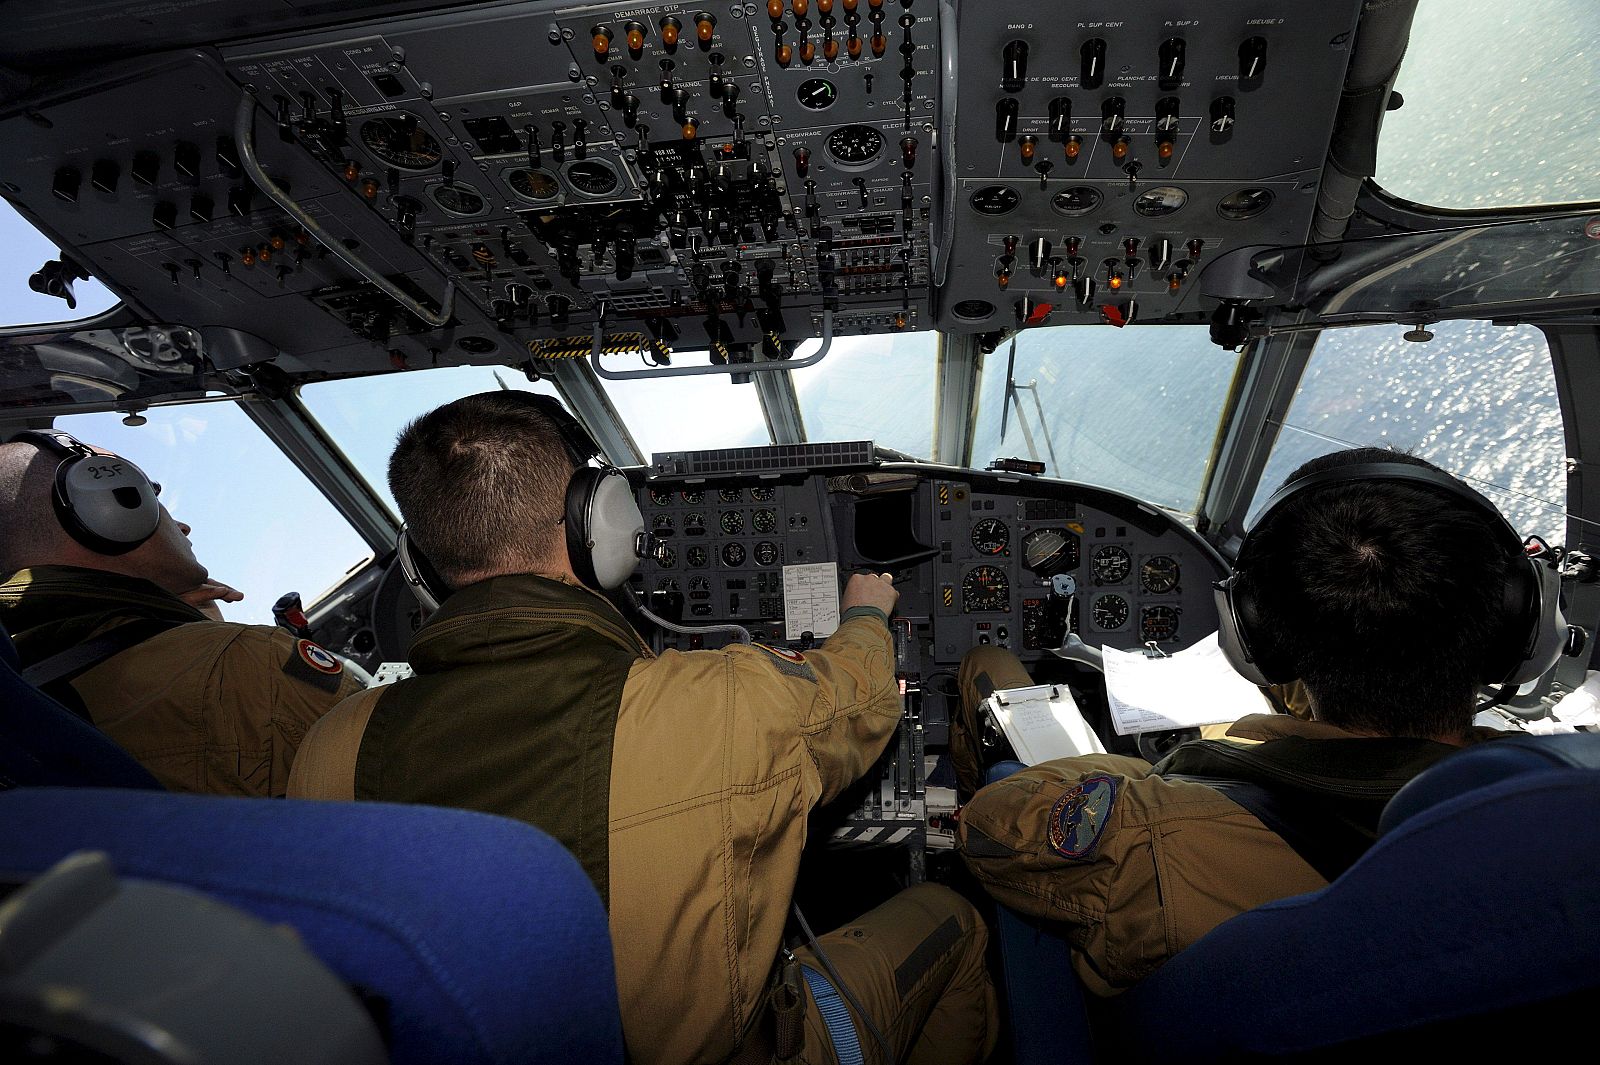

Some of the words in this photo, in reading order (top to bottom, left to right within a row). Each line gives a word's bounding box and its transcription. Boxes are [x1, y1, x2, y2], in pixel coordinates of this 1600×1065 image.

[614, 7, 661, 19] DEMARRAGE
[785, 130, 822, 139] DEGIVRAGE
[87, 463, 123, 481] 23F
